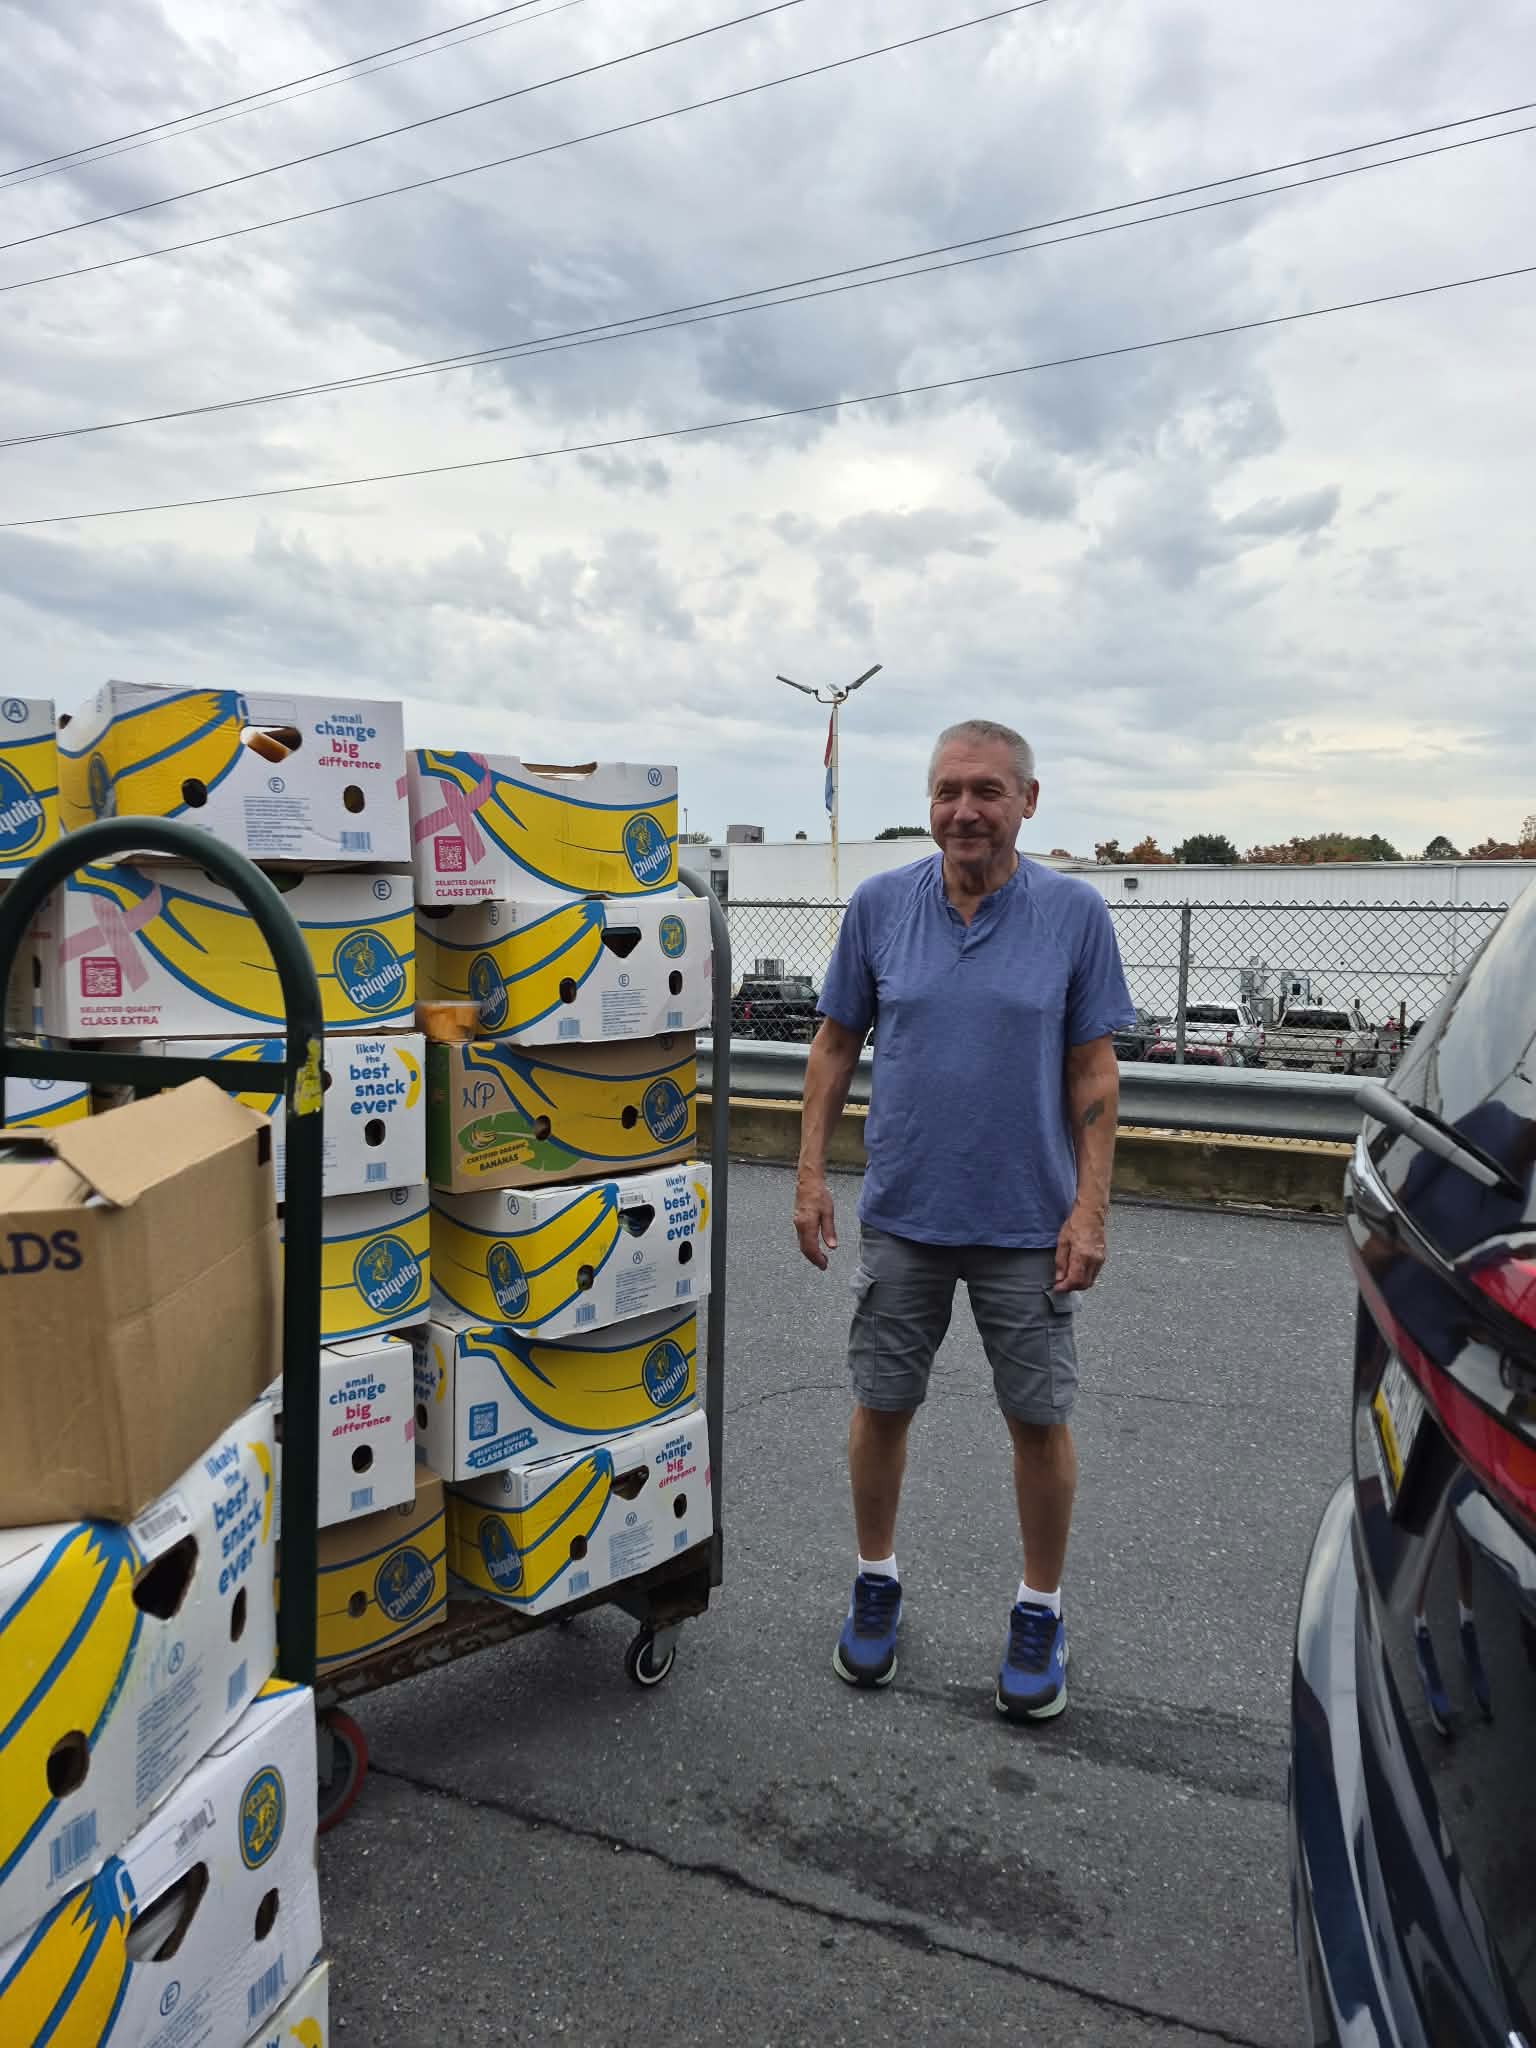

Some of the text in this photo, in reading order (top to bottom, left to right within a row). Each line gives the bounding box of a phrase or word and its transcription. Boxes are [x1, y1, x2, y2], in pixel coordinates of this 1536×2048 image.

[331, 714, 362, 724] small
[315, 721, 376, 741] change
[332, 739, 359, 758] big
[318, 757, 381, 769] difference
[633, 842, 670, 880] Chiquita
[465, 888, 493, 896] EXTRA
[349, 961, 404, 1003] Chiquita
[80, 1016, 158, 1026] CLASS EXTRA
[356, 1042, 385, 1054] likely
[350, 1063, 390, 1080] best
[355, 1079, 405, 1096] snack
[351, 1099, 397, 1115] ever
[652, 1102, 686, 1137] Chiquita
[480, 1154, 519, 1171] BANANAS
[666, 1175, 686, 1187] likely
[664, 1192, 691, 1210] best
[669, 1204, 698, 1224] snack
[667, 1222, 695, 1240] ever
[0, 1229, 83, 1275] DS
[367, 1261, 419, 1309] Chiquita
[496, 1278, 528, 1306] Chiquita
[345, 1374, 373, 1388] small
[650, 1361, 687, 1403] Chiquita
[329, 1383, 386, 1405] change
[346, 1404, 371, 1420] big
[332, 1415, 391, 1437] difference
[666, 1435, 684, 1449] small
[656, 1441, 692, 1464] change
[666, 1459, 684, 1472] big
[659, 1466, 696, 1488] difference
[212, 1477, 249, 1531] best
[222, 1500, 261, 1558] snack
[219, 1536, 256, 1595] ever
